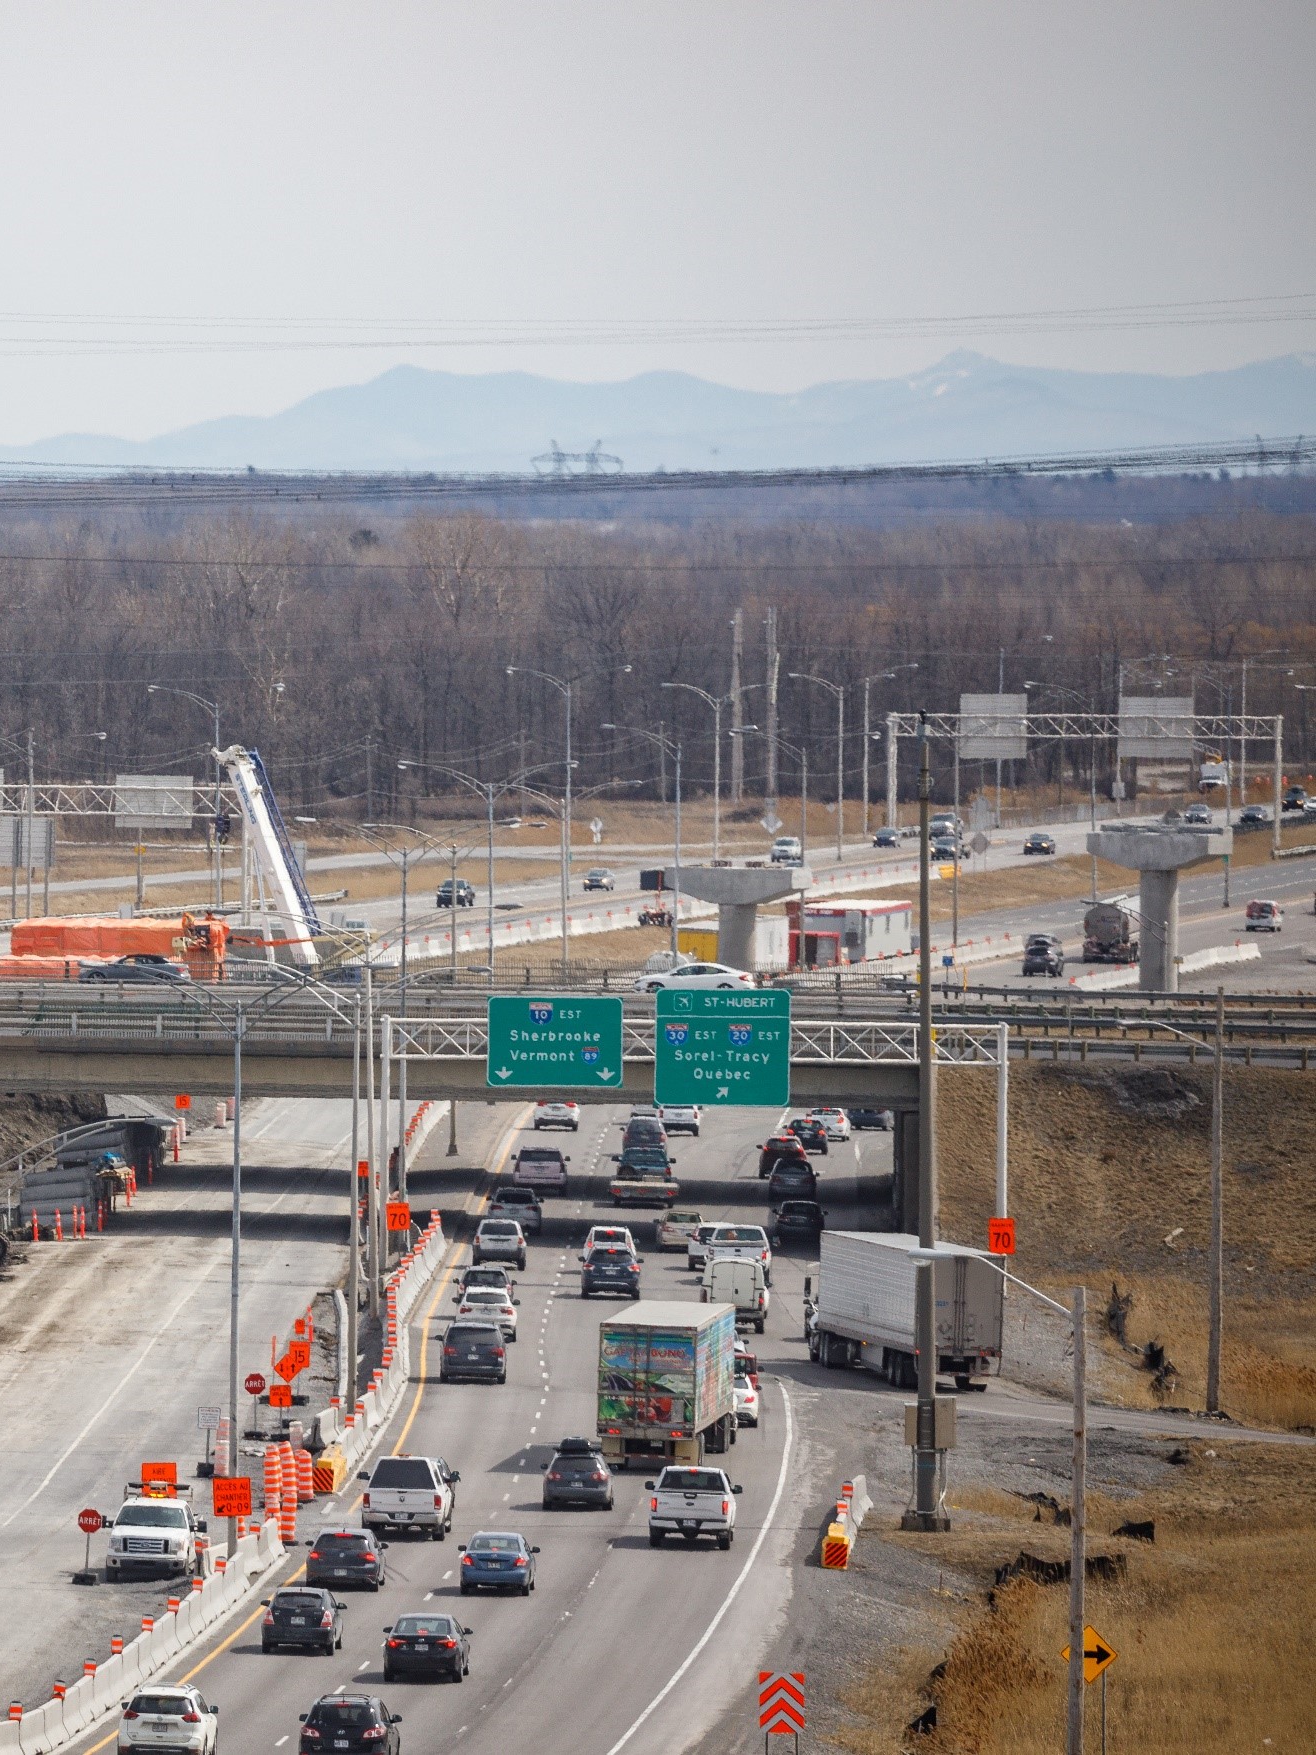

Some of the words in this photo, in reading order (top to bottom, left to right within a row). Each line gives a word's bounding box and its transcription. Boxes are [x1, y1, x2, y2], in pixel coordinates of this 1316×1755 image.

[704, 997, 776, 1008] ST-HUBERT
[534, 1010, 548, 1019] 10
[559, 1010, 582, 1019] EST
[509, 1029, 601, 1042] Sherbrooke
[669, 1031, 685, 1040] 30
[694, 1030, 717, 1040] EST
[732, 1031, 748, 1040] 20
[758, 1031, 781, 1041] EST
[509, 1050, 575, 1061] Vermont
[584, 1052, 598, 1060] 89
[674, 1049, 770, 1065] Sorel-Tracy
[693, 1067, 751, 1080] Québec
[390, 1213, 406, 1226] 70
[993, 1232, 1010, 1248] 70
[294, 1350, 305, 1363] 15
[216, 1493, 248, 1501] CHANTIER
[79, 1516, 101, 1526] ARRÊT
